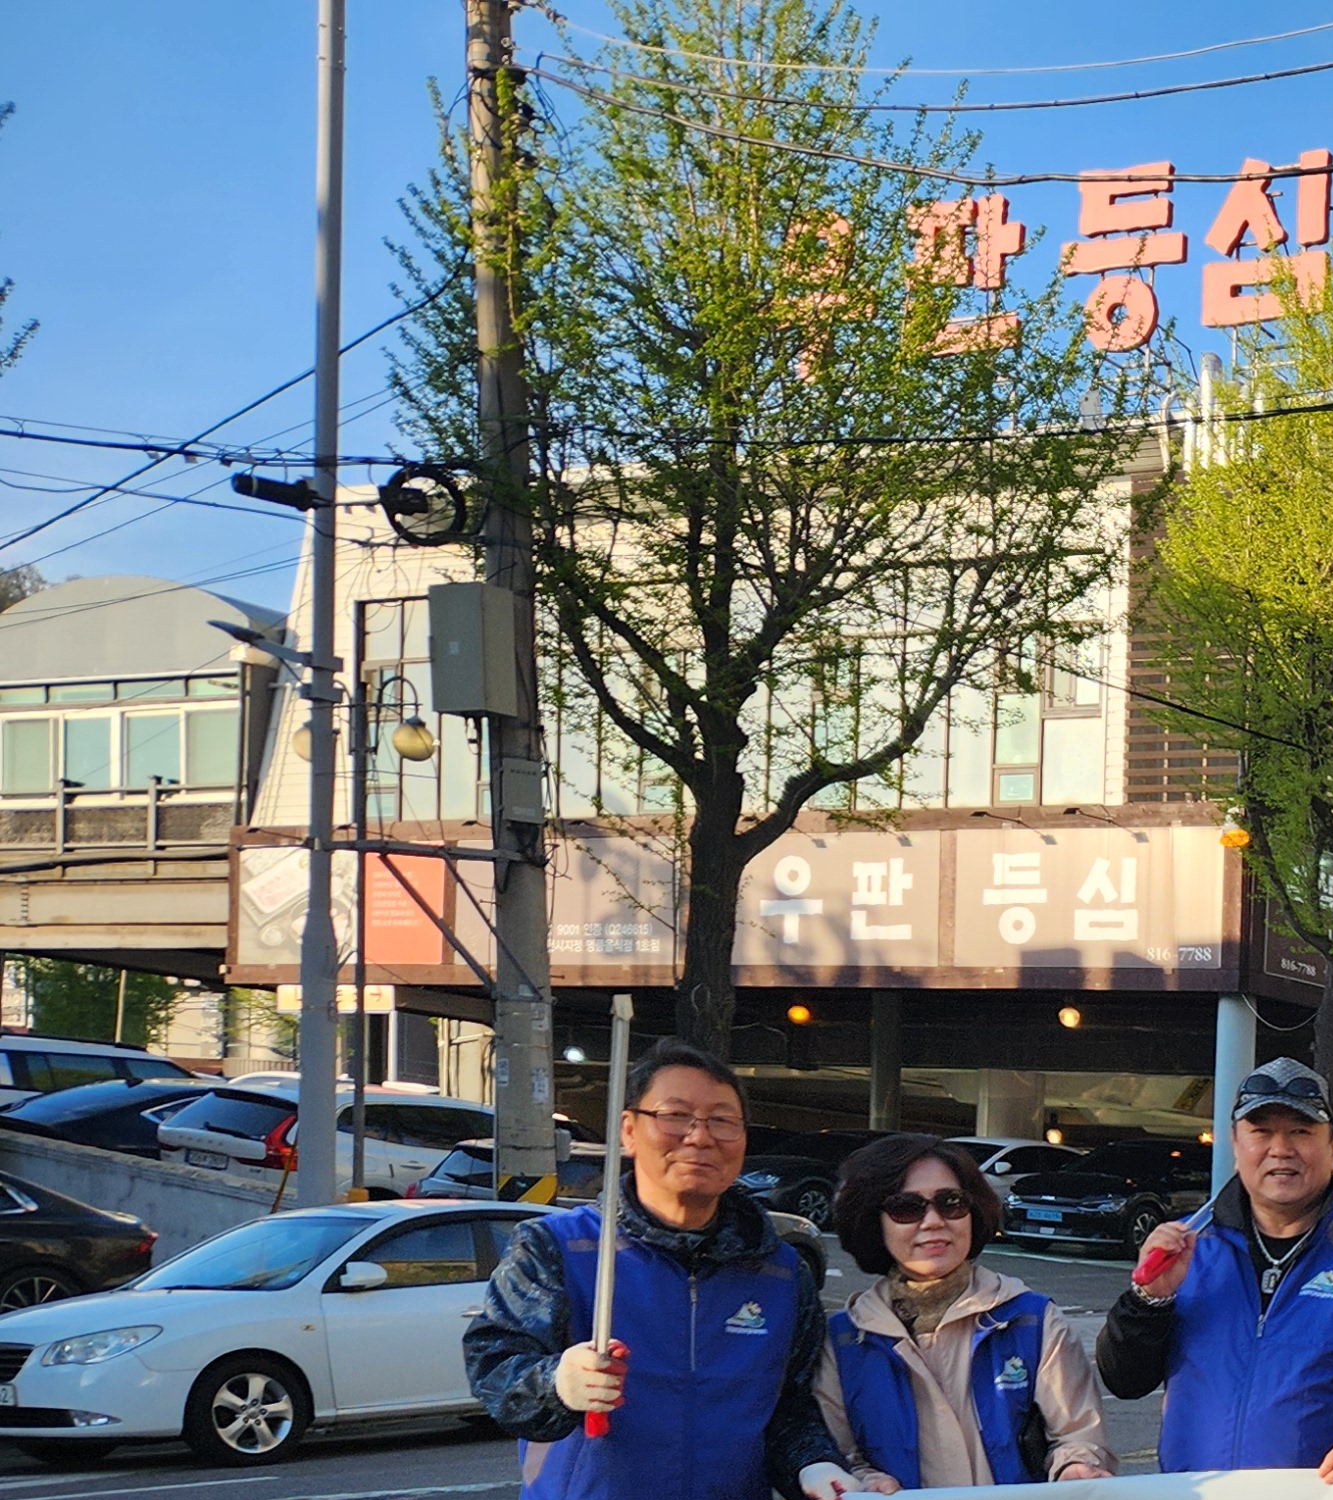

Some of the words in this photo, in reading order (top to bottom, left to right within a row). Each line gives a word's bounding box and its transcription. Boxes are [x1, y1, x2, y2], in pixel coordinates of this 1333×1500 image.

[557, 923, 581, 936] 9001
[1146, 946, 1212, 963] 816-7788
[1281, 958, 1317, 977] 816-7788
